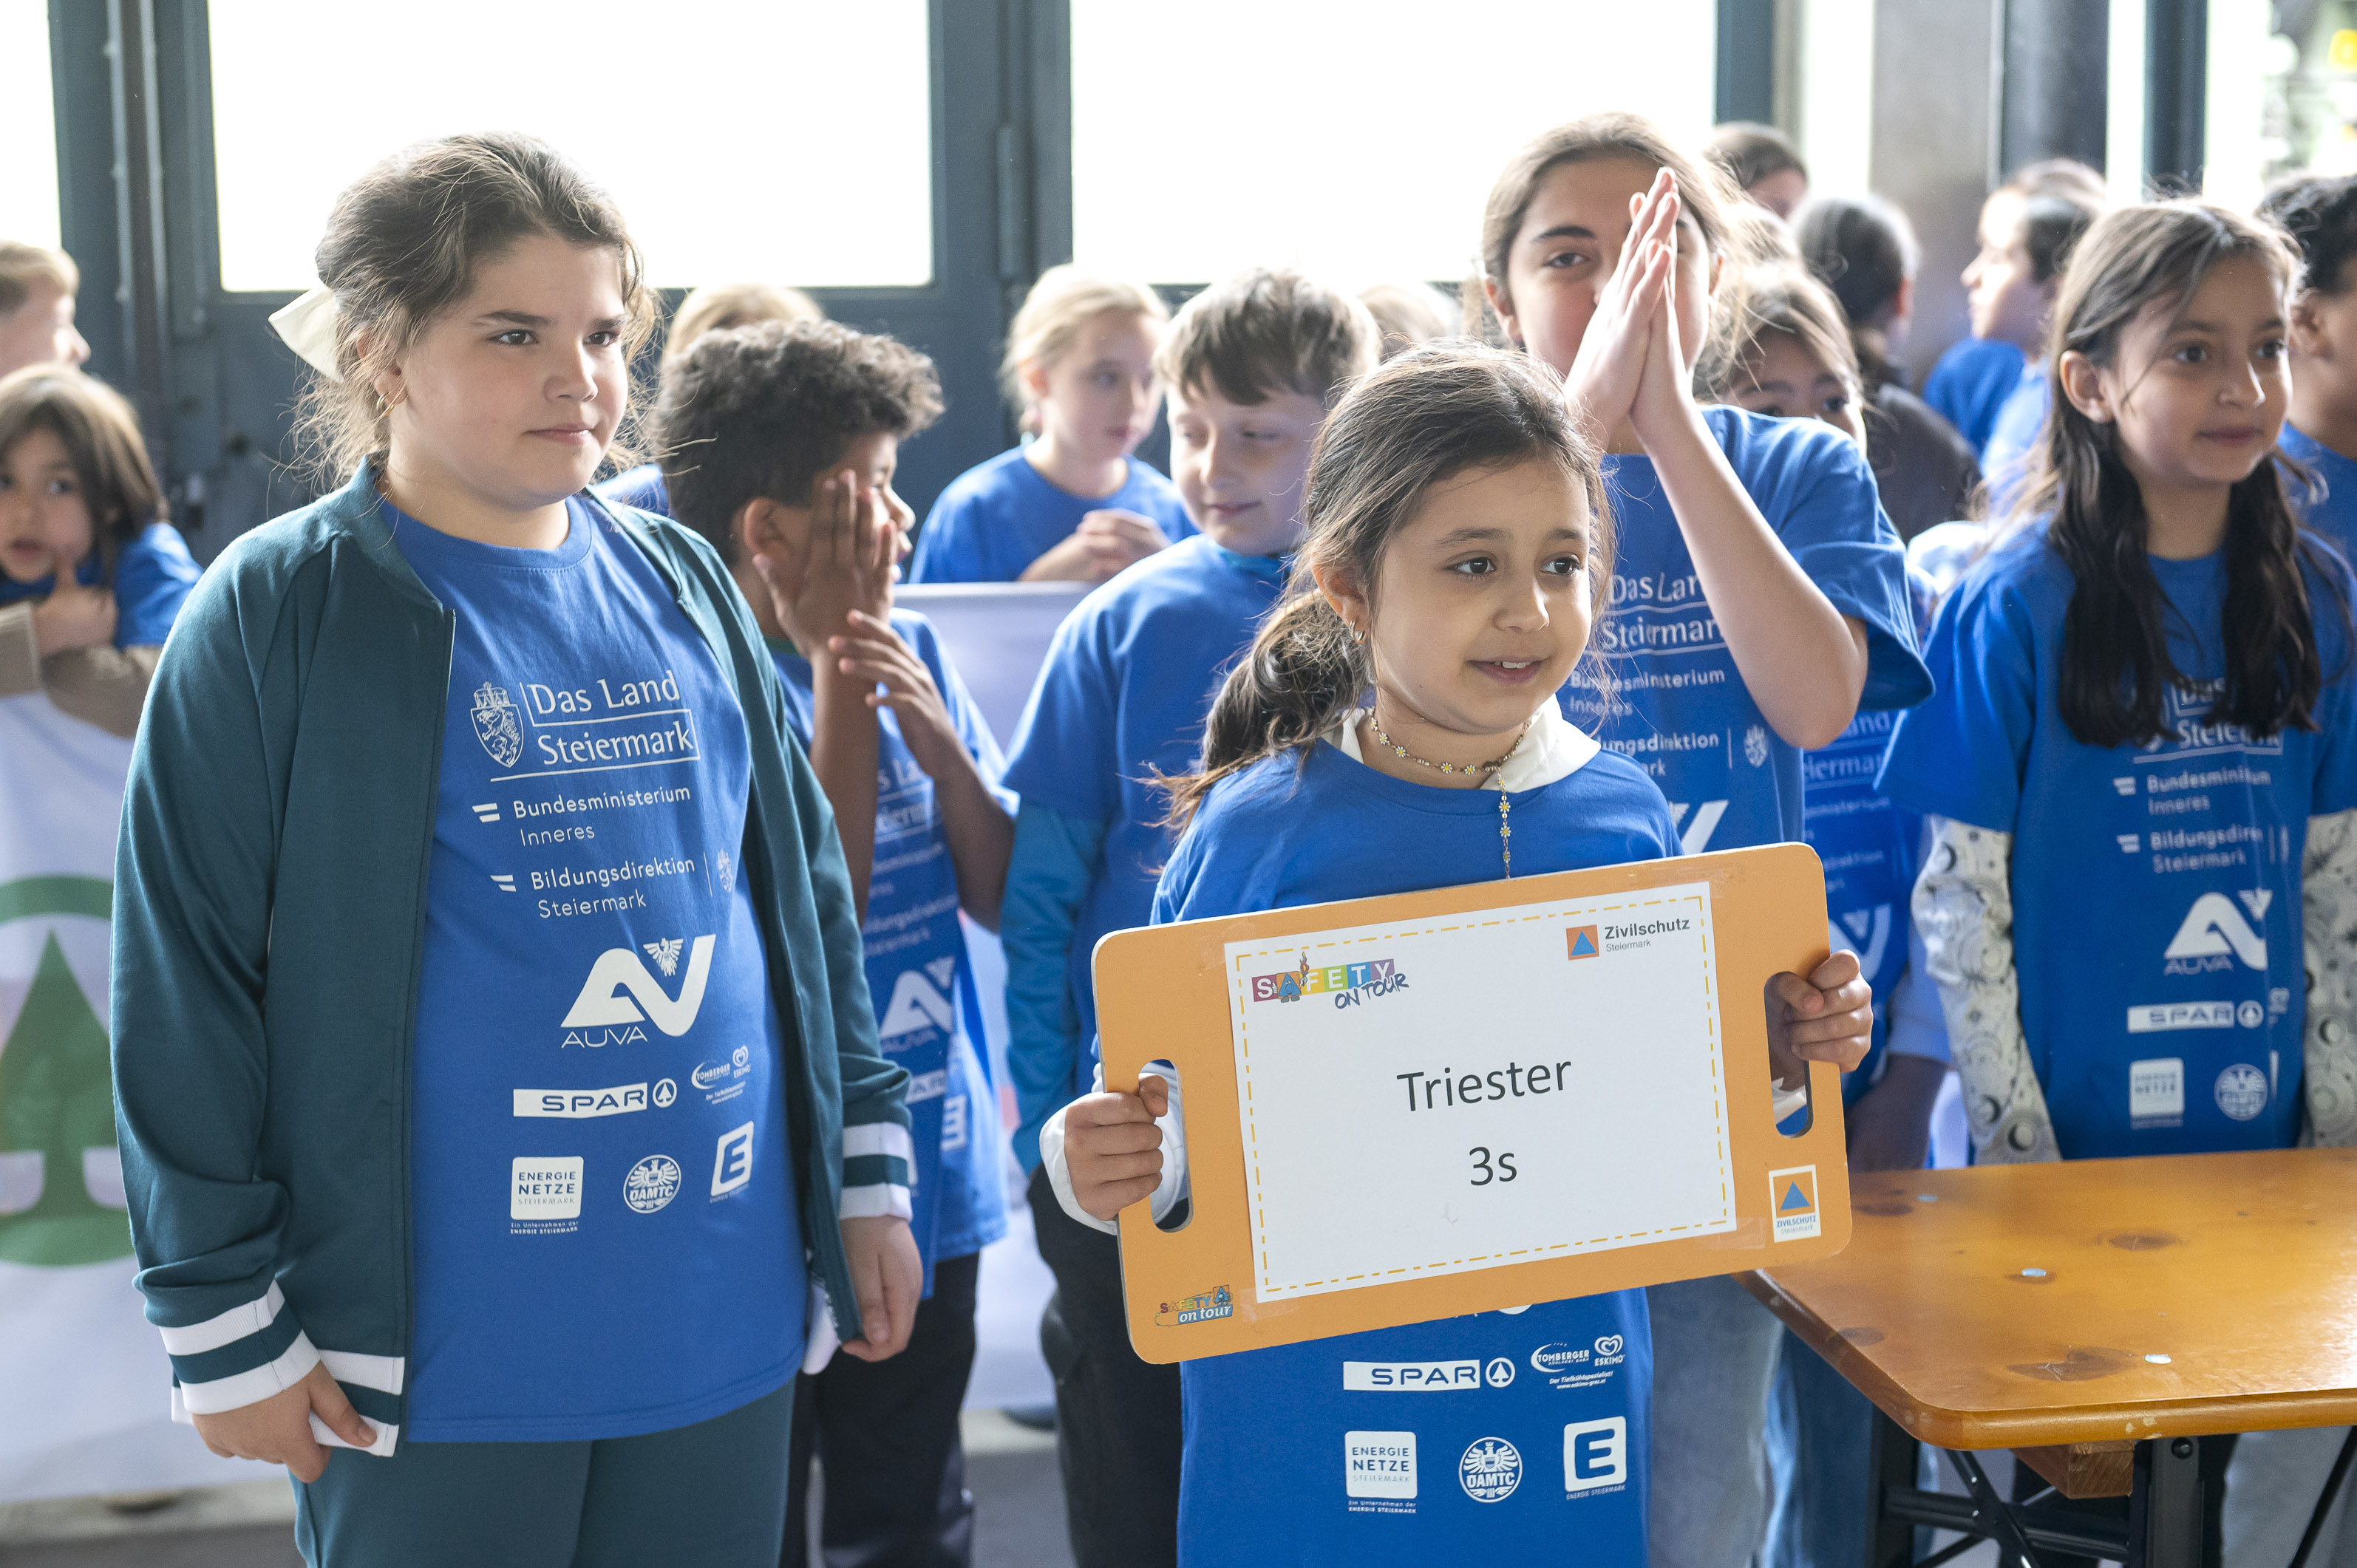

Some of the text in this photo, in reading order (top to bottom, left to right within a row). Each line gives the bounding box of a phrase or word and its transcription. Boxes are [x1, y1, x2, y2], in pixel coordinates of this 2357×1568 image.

[1609, 574, 1653, 604] Das
[527, 669, 680, 715] Das Land
[537, 720, 694, 766] Steiermark
[513, 786, 691, 819] Bundesministerium
[520, 825, 596, 848] Inneres
[531, 856, 695, 890] Bildungsdirektion
[538, 889, 647, 918] Steiermark
[1605, 918, 1690, 940] Zivilschutz
[1606, 939, 1651, 952] Steiermark
[1334, 972, 1409, 1009] ON TOUR
[2149, 1005, 2231, 1024] SPAR
[562, 1026, 647, 1049] AUVA
[1396, 1061, 1571, 1112] Triester
[542, 1088, 644, 1112] SPAR
[720, 1133, 748, 1184] E
[1469, 1146, 1517, 1186] 3s
[519, 1171, 576, 1181] ENERGIE
[518, 1183, 575, 1195] NETZE
[517, 1196, 575, 1205] STEIERMARK
[540, 1227, 578, 1235] STEIERMARK
[1776, 1215, 1817, 1228] ZIVILSCHUTZ
[1160, 1295, 1211, 1314] SAFETY
[1179, 1306, 1231, 1323] on tour
[1537, 1349, 1590, 1363] TOMBERGER
[1371, 1365, 1477, 1385] SPAR
[1352, 1447, 1409, 1456] ENERGIE
[1574, 1428, 1616, 1480] E
[1353, 1459, 1409, 1472] NETZE
[1353, 1474, 1410, 1482] STEIERMARK
